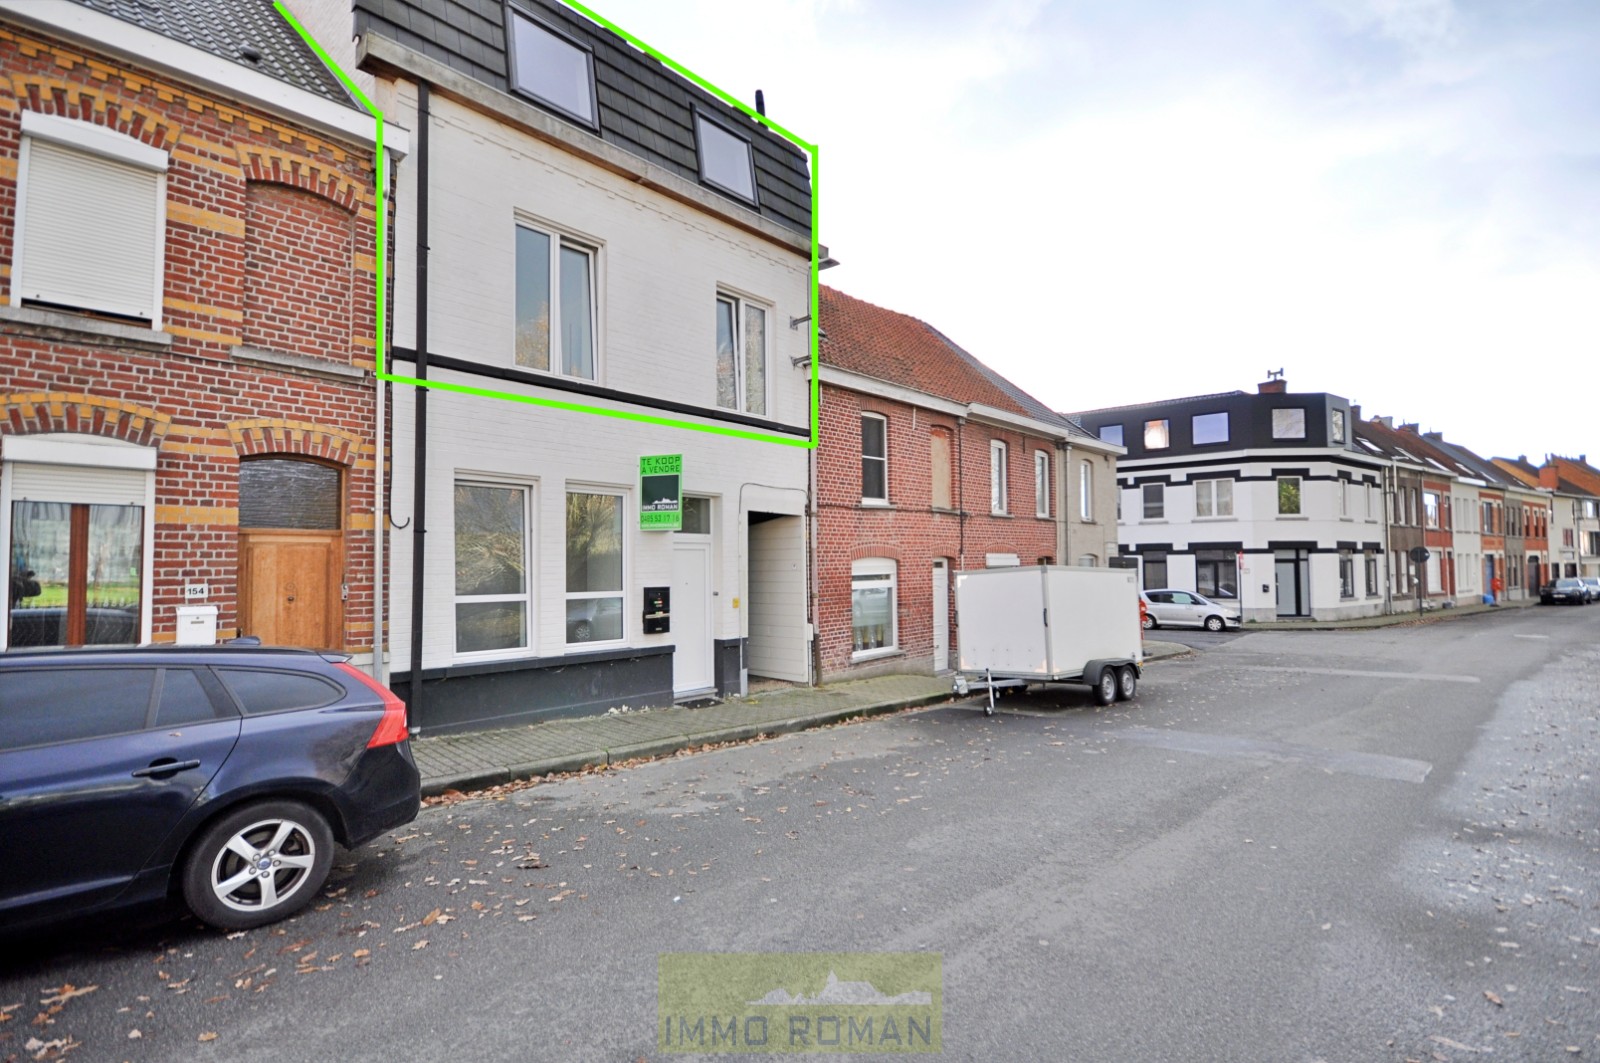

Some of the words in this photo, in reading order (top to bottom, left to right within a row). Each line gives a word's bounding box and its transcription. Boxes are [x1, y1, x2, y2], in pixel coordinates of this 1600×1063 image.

[656, 456, 680, 465] KOOP
[650, 464, 680, 474] VENDRE
[188, 587, 204, 595] 154
